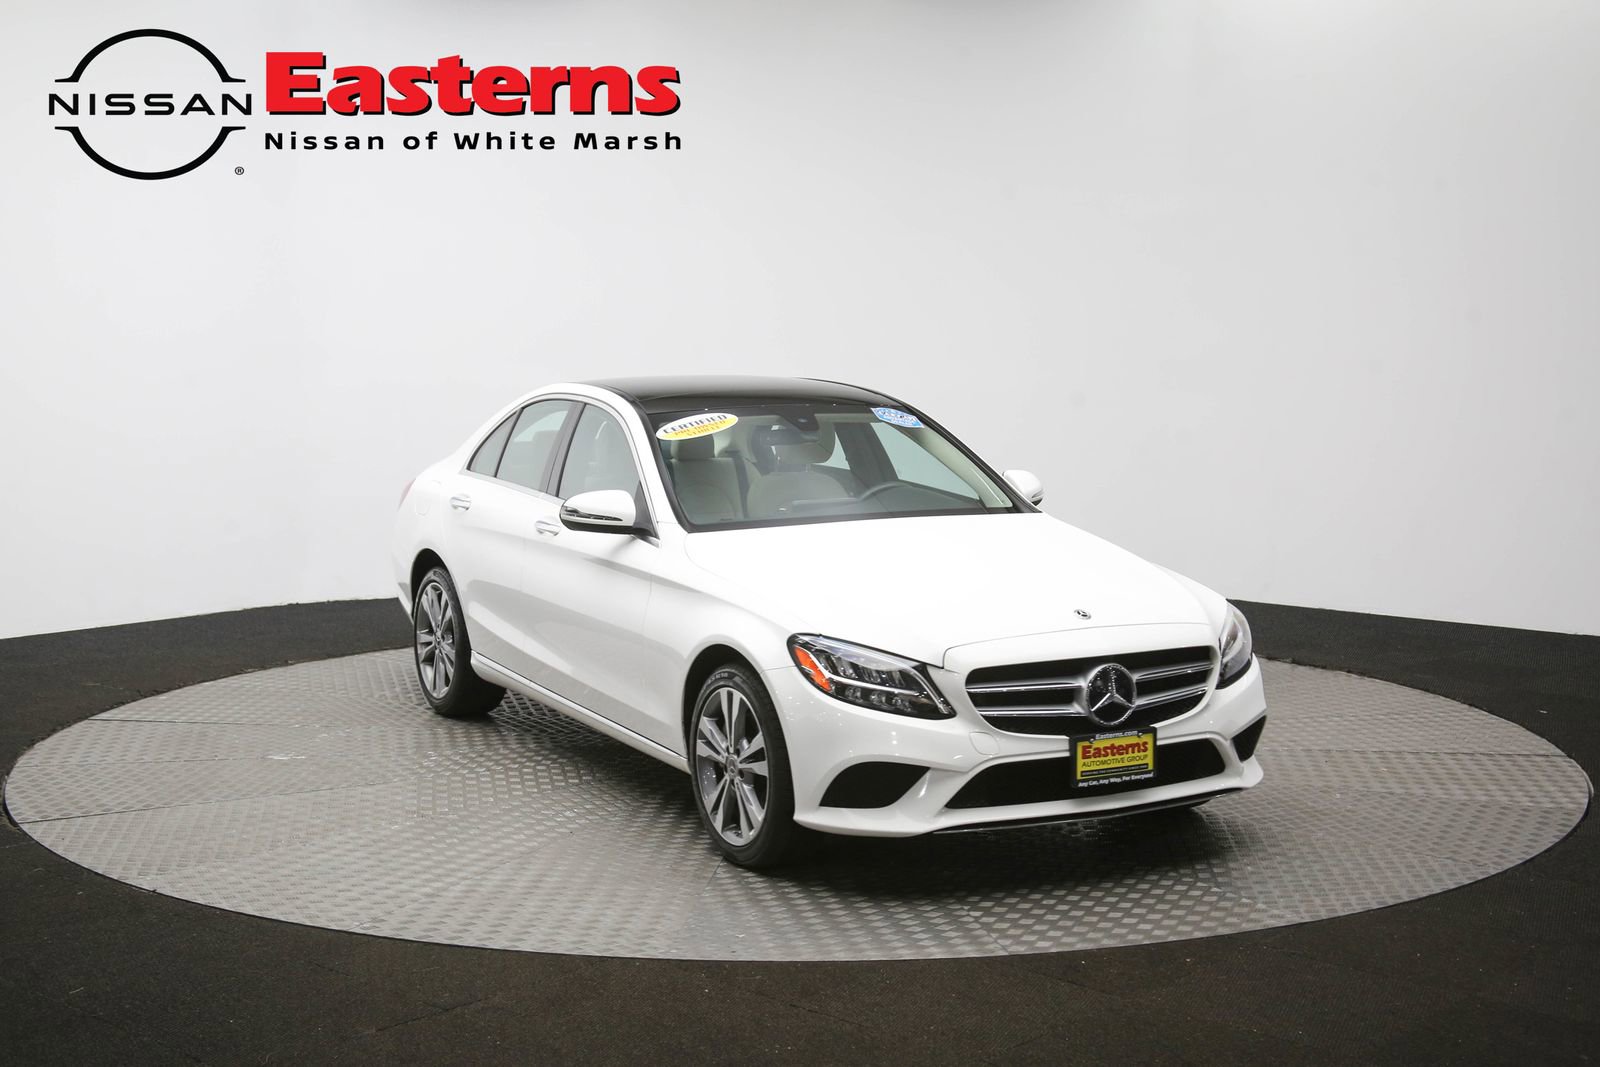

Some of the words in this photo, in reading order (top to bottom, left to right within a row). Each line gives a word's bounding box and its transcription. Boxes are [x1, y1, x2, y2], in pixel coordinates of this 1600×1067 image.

[1095, 730, 1139, 740] Easterns.com
[1081, 741, 1149, 760] Easterns
[1081, 757, 1126, 768] AUTOMOTIVE
[1126, 753, 1149, 763] GROUP
